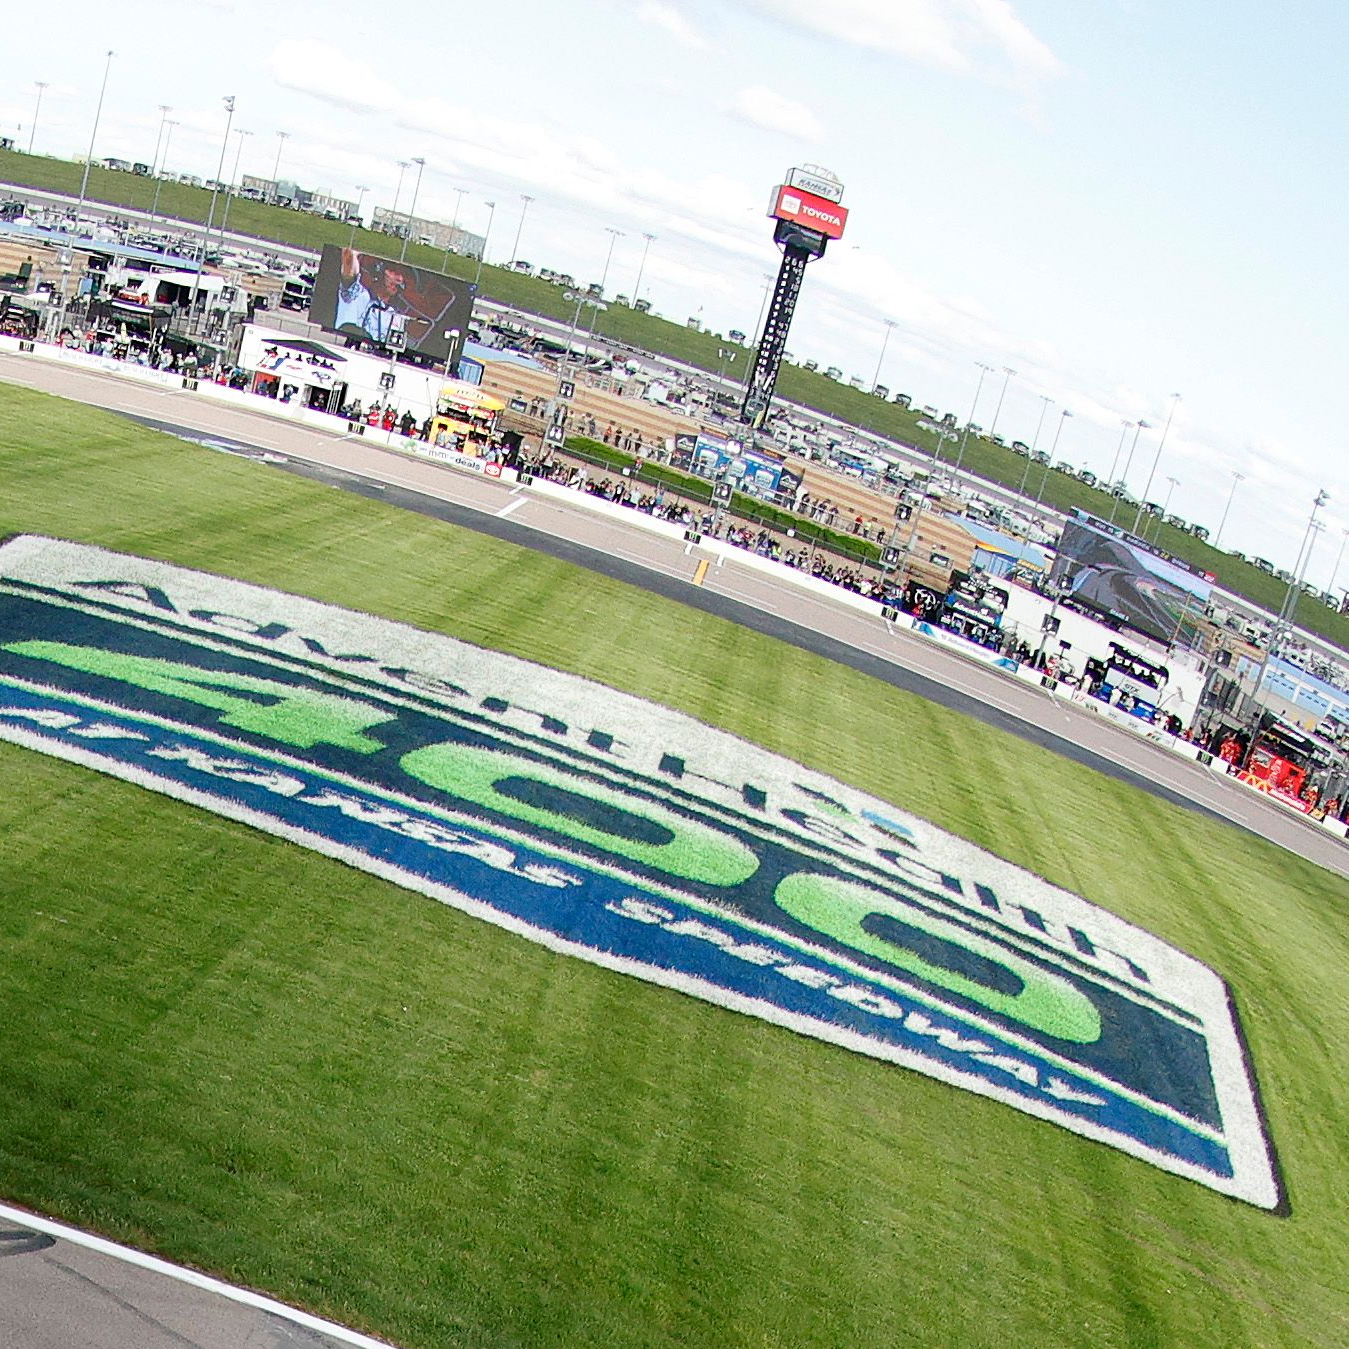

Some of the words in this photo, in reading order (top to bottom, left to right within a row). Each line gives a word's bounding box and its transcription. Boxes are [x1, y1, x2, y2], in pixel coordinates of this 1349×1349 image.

[802, 205, 841, 226] TOYOTA
[455, 457, 481, 471] deals
[0, 639, 1103, 1043] 400
[71, 580, 1149, 983] AdventHealth
[146, 742, 584, 888] KANSAS
[605, 897, 1107, 1106] SPEEDWAY
